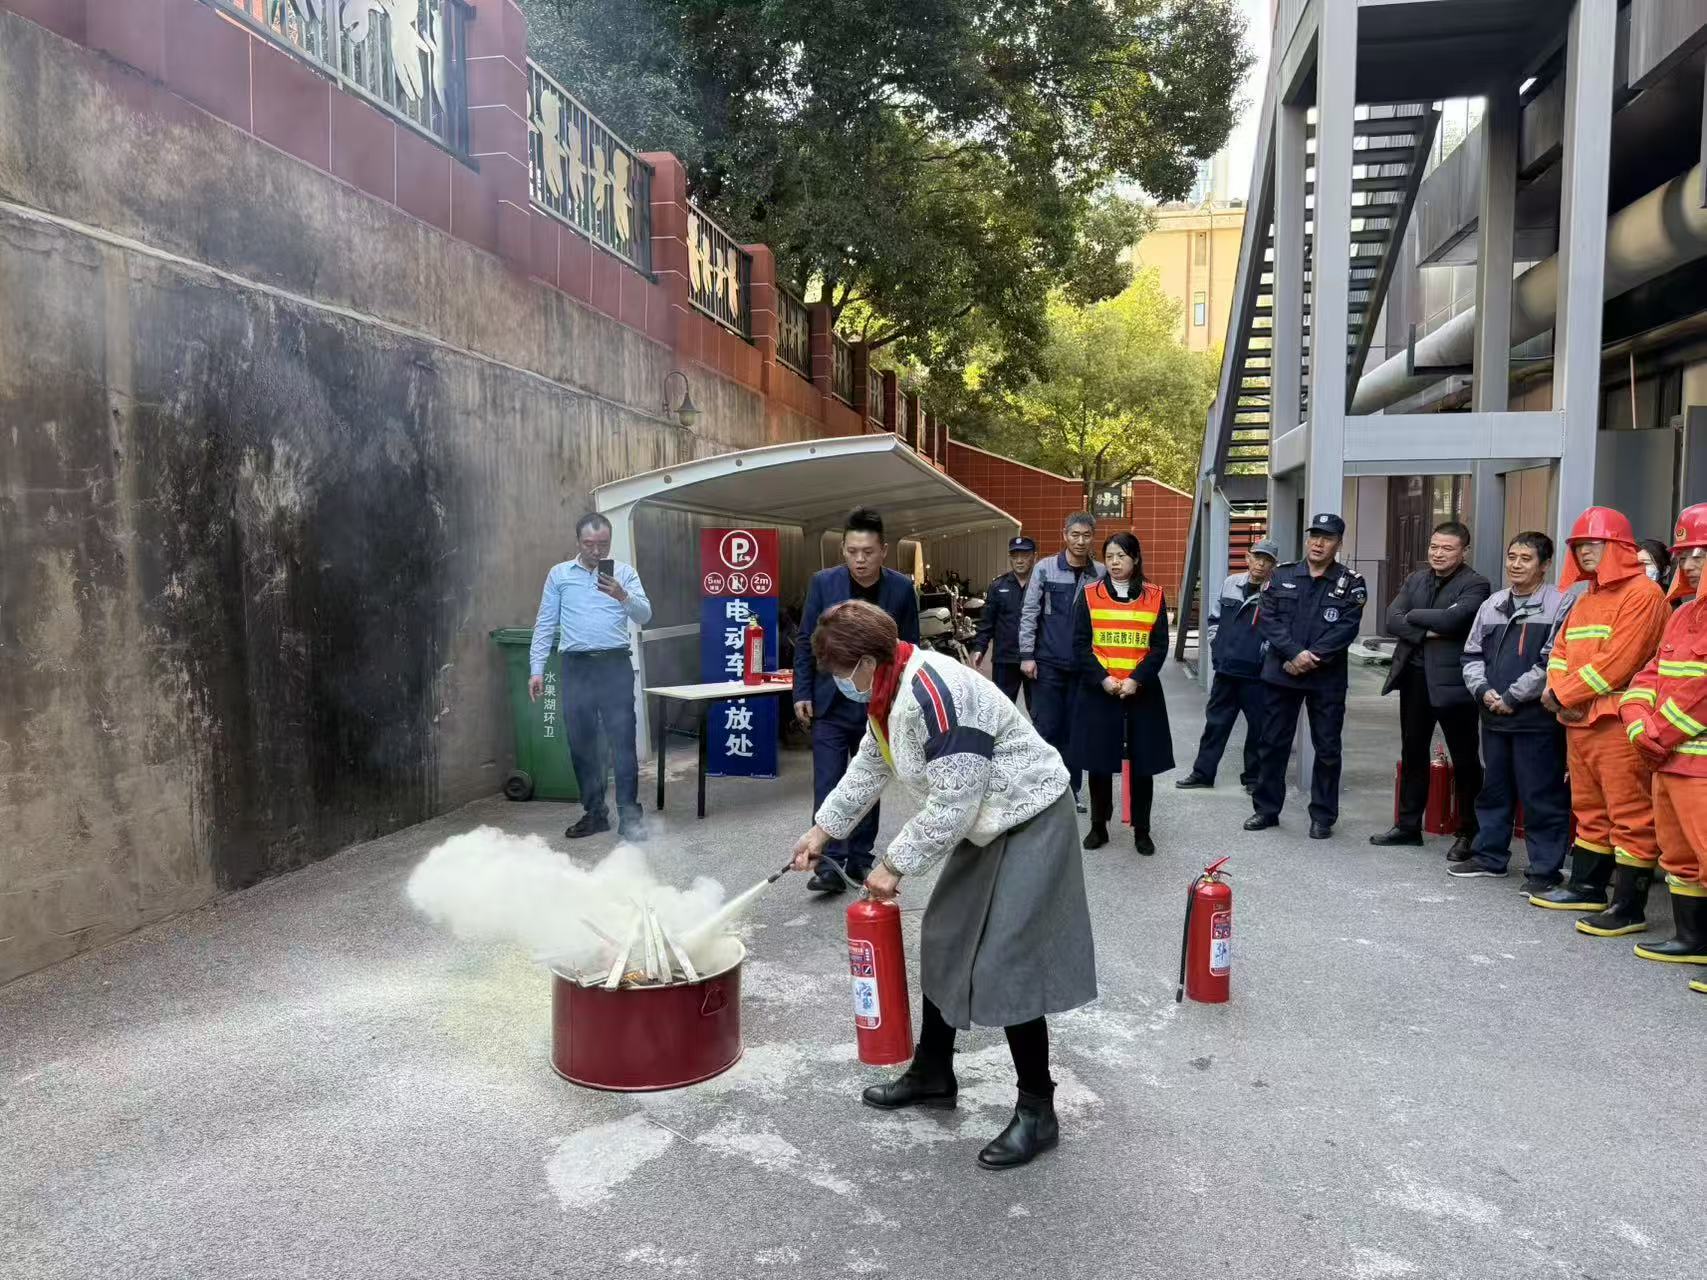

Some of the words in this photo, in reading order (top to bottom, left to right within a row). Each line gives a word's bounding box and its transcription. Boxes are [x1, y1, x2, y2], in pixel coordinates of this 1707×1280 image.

[731, 537, 750, 563] P
[754, 576, 769, 585] 2m
[1099, 631, 1148, 645] 消防疏散引导员
[724, 598, 753, 757] 电动车放处
[543, 671, 557, 738] 水果湖环卫
